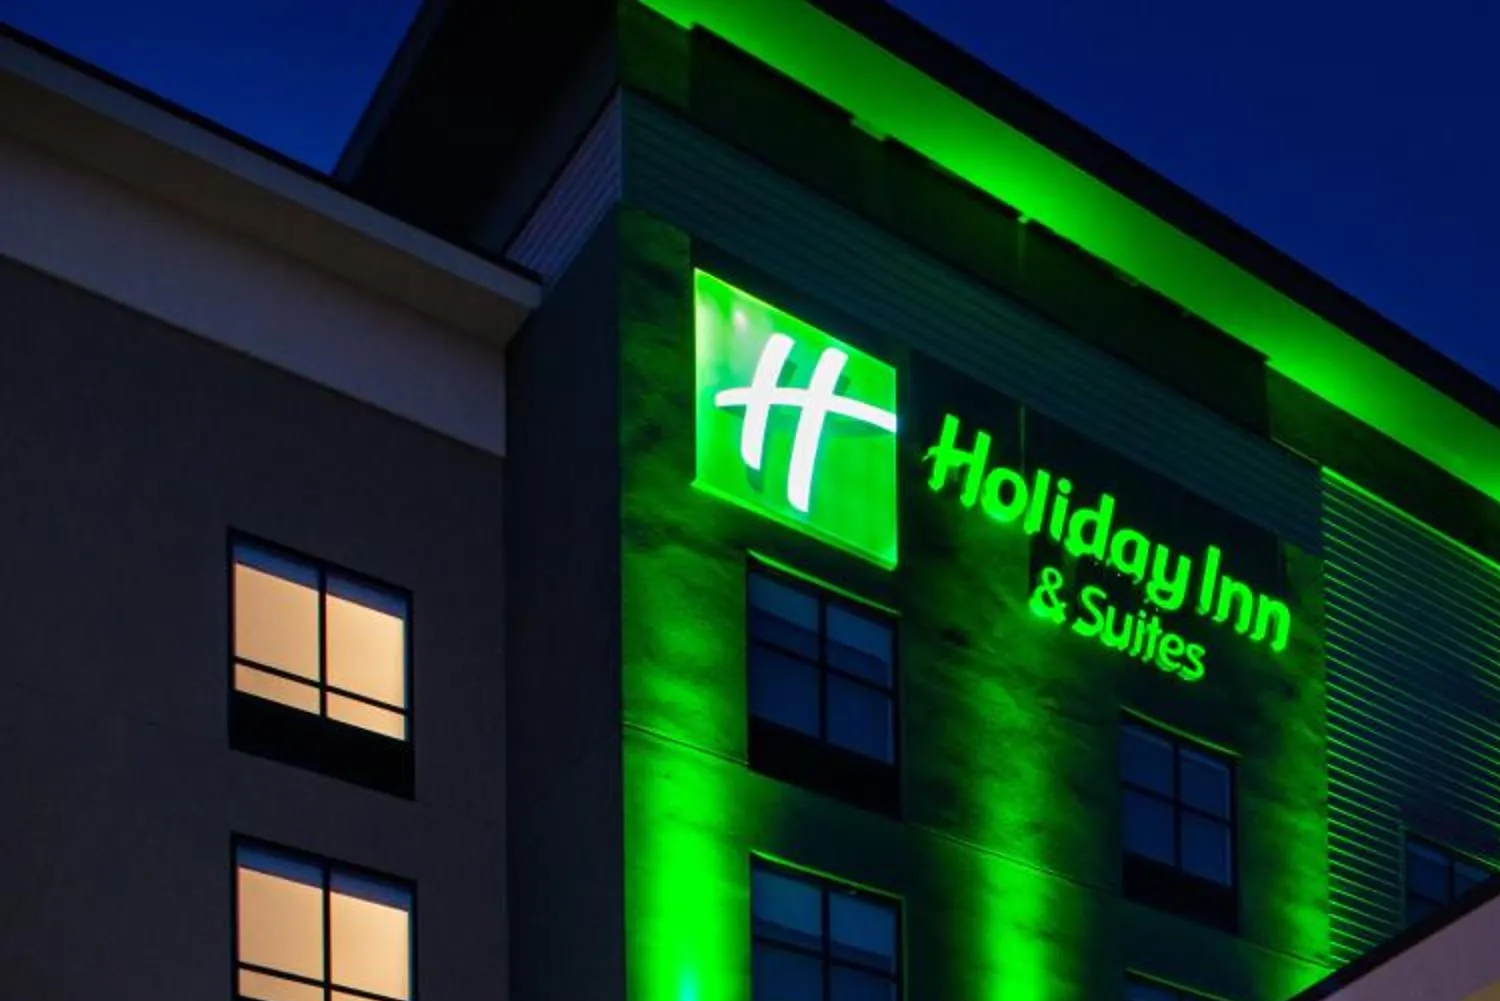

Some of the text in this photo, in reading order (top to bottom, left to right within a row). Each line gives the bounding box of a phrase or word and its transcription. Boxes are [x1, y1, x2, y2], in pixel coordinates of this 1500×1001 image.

[714, 333, 897, 512] H
[924, 413, 1291, 652] Holiday Inn
[1028, 567, 1206, 682] & Suites
